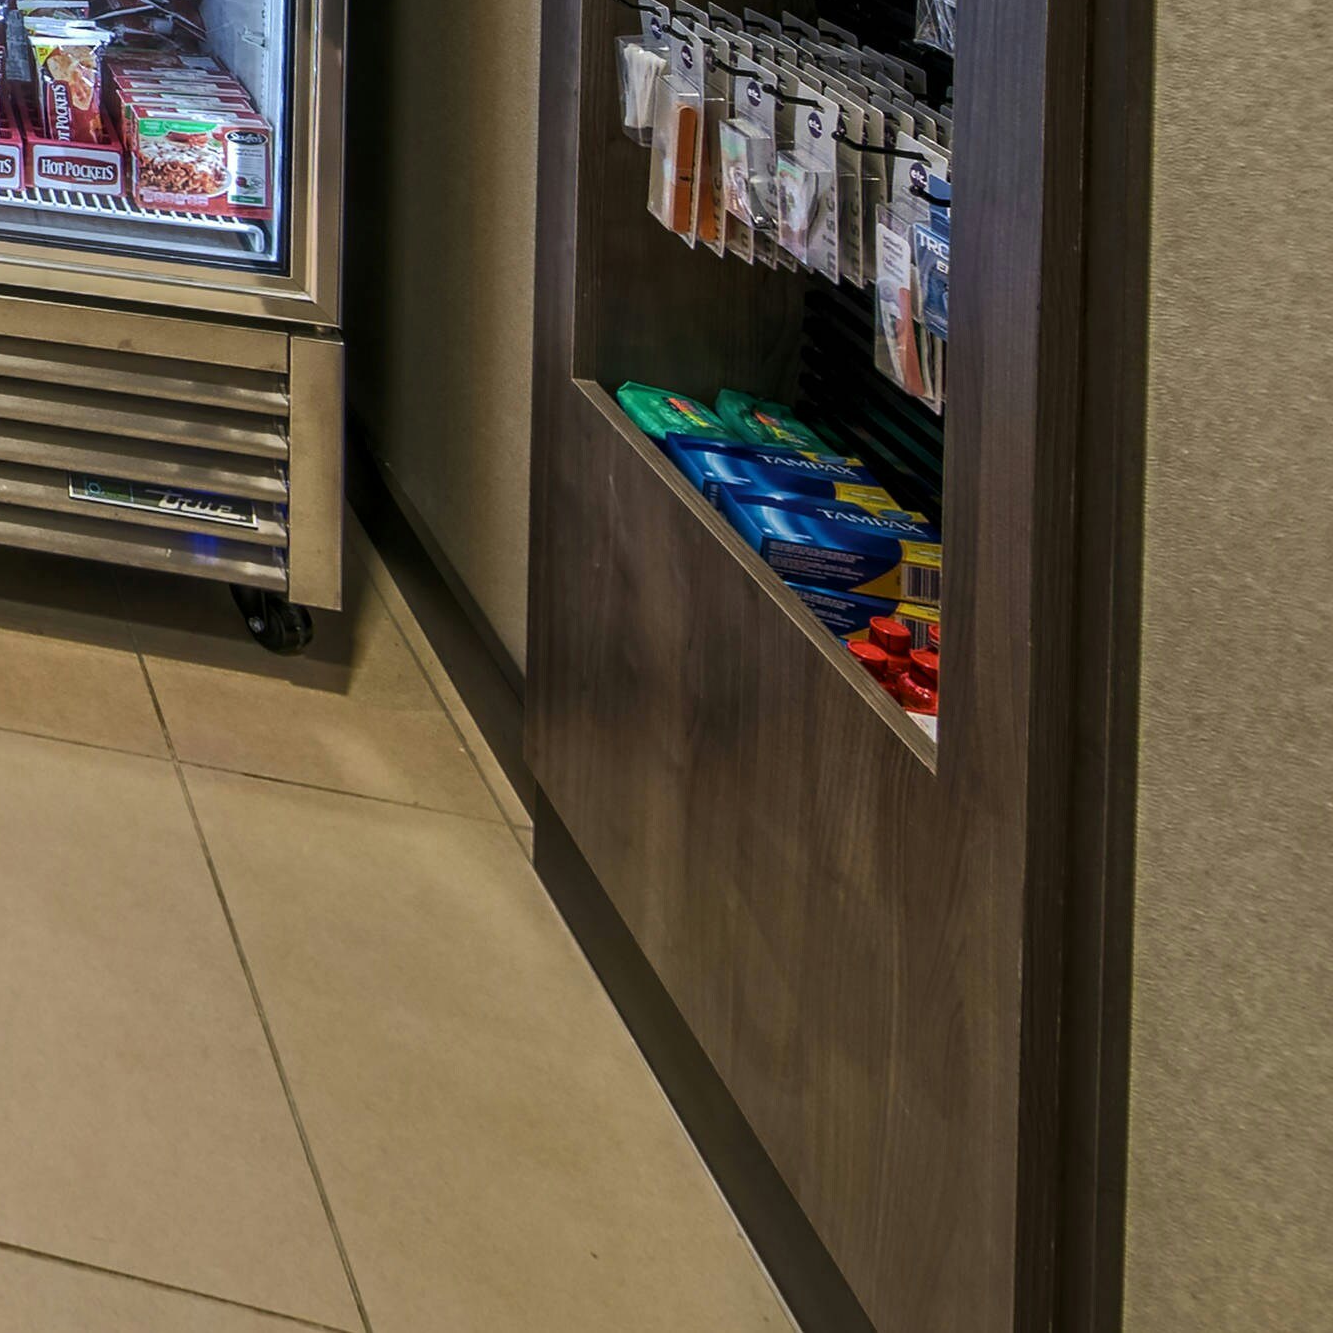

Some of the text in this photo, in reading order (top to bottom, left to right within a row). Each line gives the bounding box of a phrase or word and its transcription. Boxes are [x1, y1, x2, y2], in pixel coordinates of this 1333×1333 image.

[41, 159, 114, 181] HOT POCKETS
[757, 453, 859, 478] TAMPAX
[146, 488, 245, 520] True
[816, 507, 928, 535] TAMPAX
